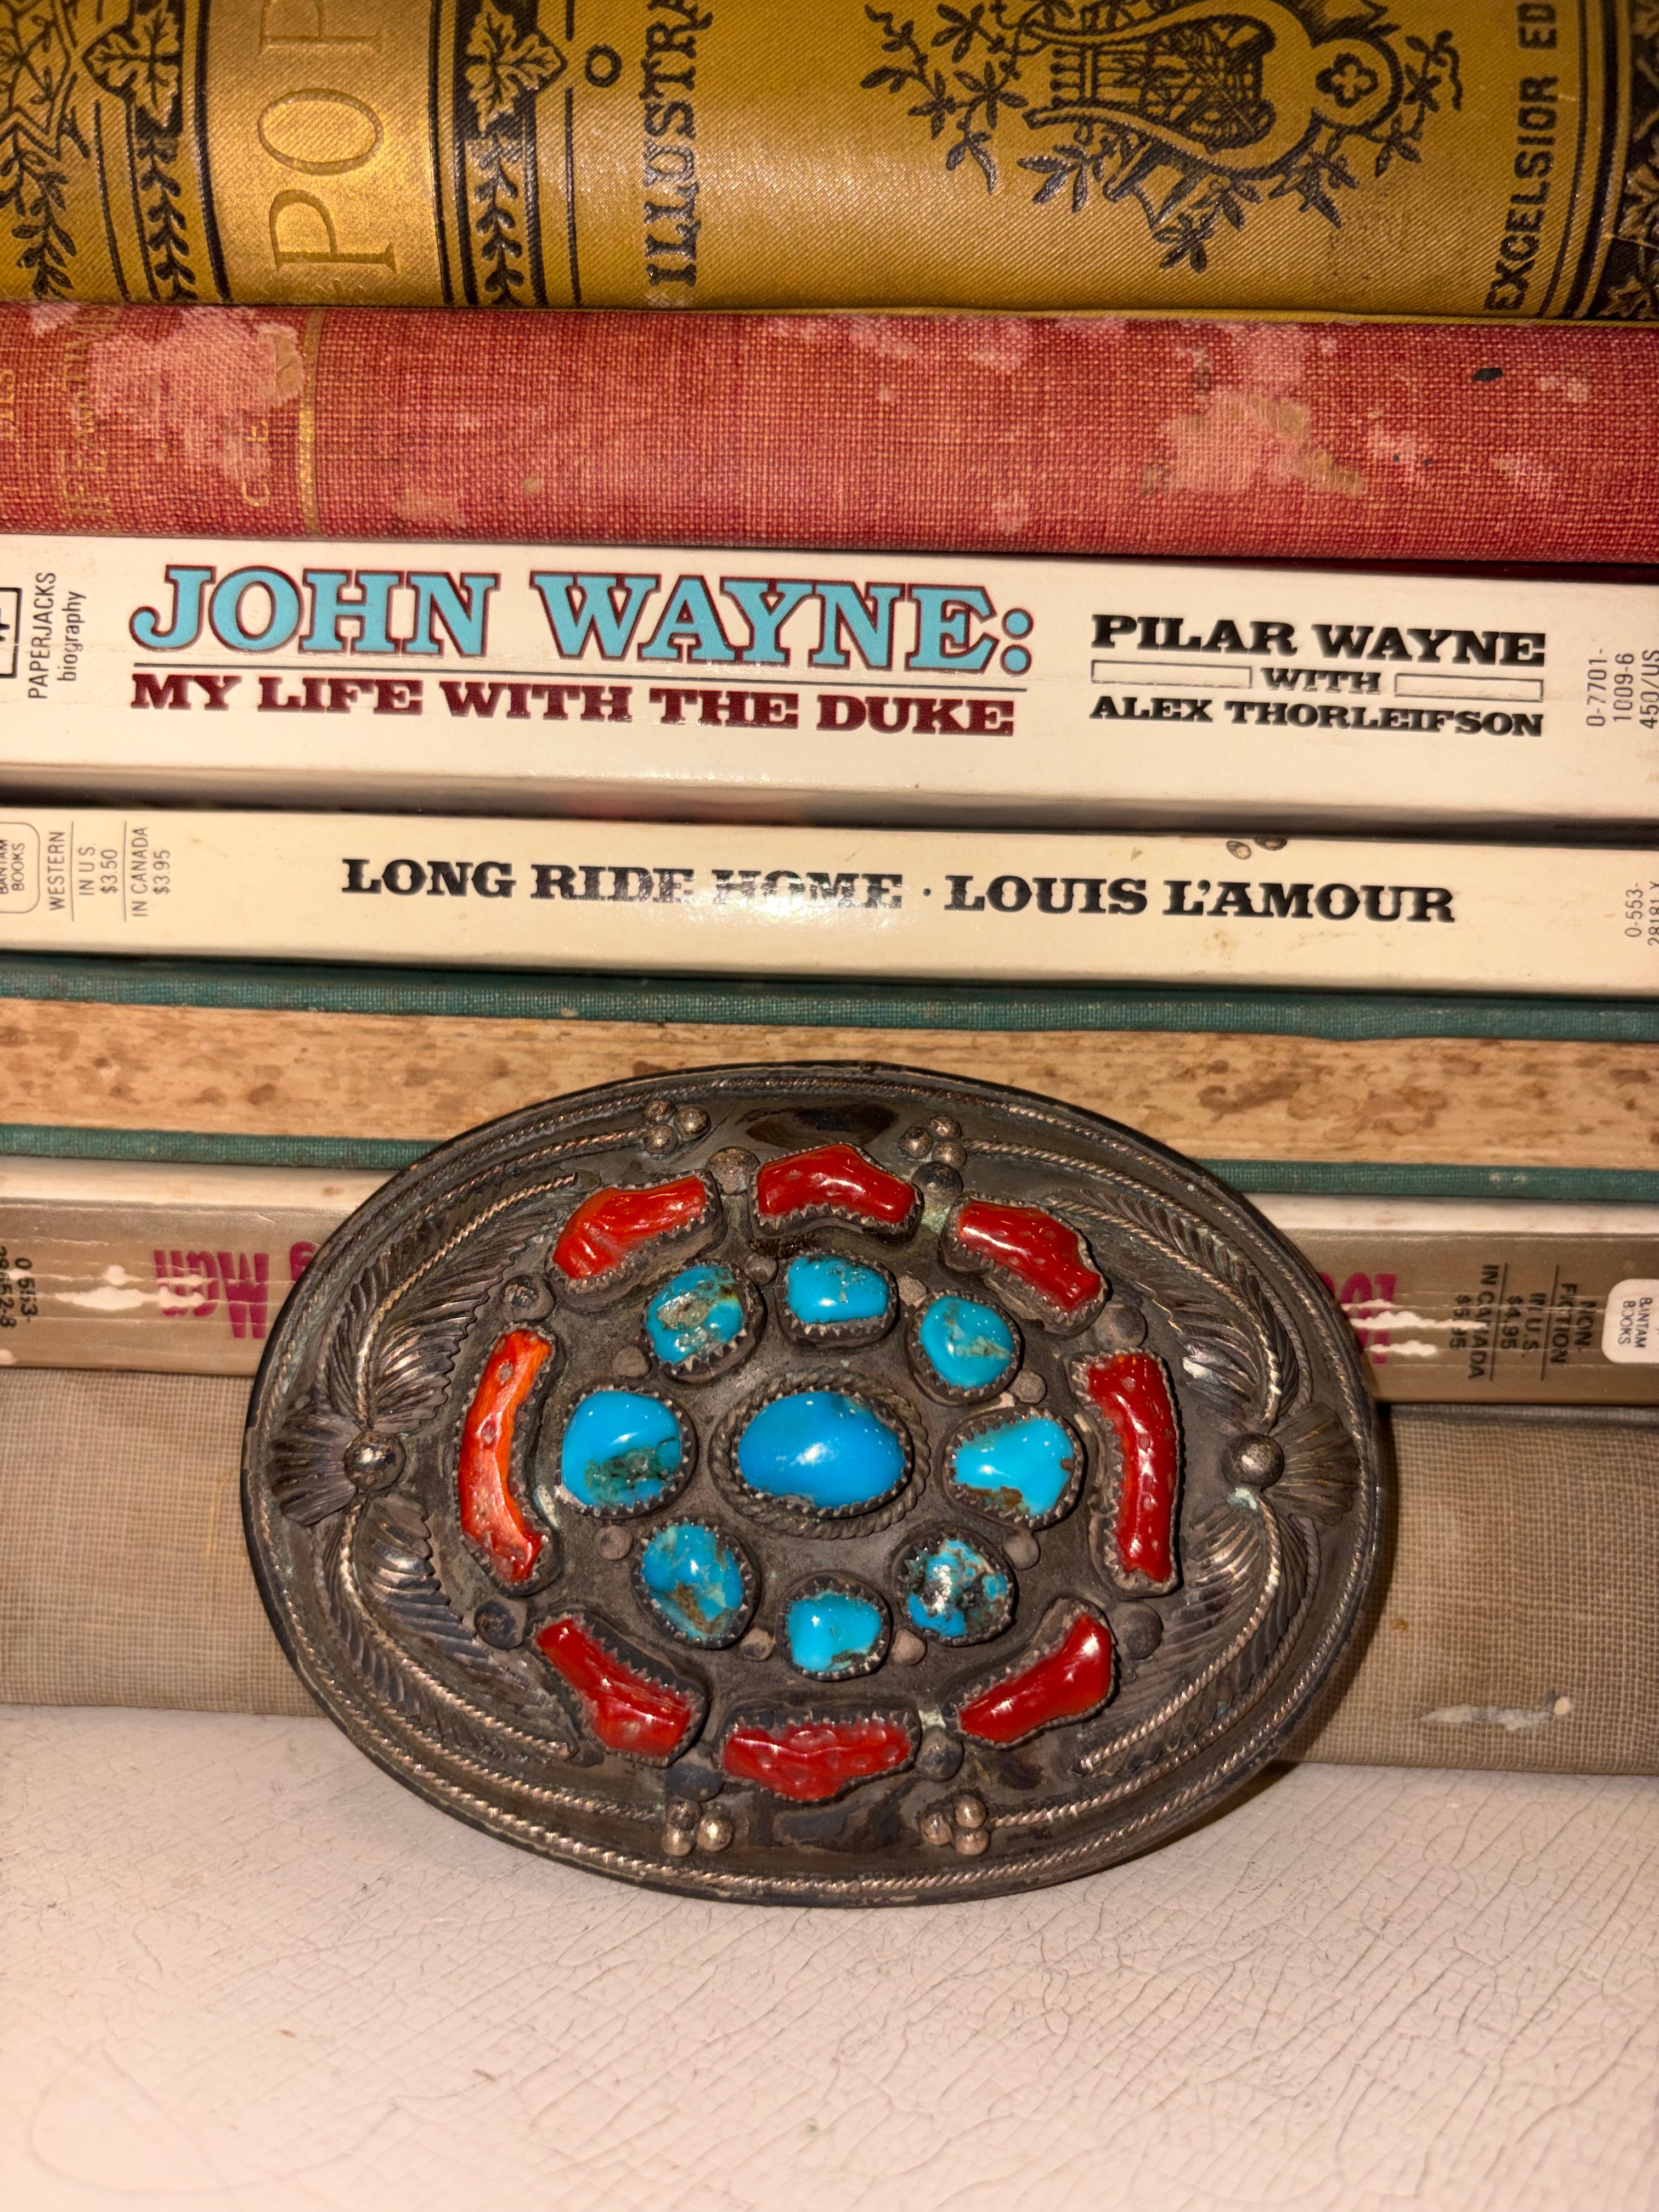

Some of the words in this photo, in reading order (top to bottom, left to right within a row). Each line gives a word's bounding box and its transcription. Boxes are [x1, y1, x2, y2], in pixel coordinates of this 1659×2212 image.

[1516, 3, 1557, 50] ED
[1483, 75, 1559, 311] EXCELSIOR
[29, 572, 57, 698] PAPERJACKS
[57, 591, 87, 681] biography
[129, 565, 501, 658] JOHN
[529, 570, 1034, 676] WAYNE:
[1091, 614, 1297, 657] PILAR
[1312, 624, 1546, 667] WAYNE
[131, 674, 242, 711] MY
[257, 677, 424, 715] LIFE
[439, 681, 632, 722] WITH
[650, 687, 798, 729] THE
[816, 694, 1014, 736] DUKE
[1260, 667, 1381, 695] WITH
[1585, 647, 1607, 727] 0-7701-
[1613, 652, 1634, 722] 1009-6
[1639, 648, 1659, 729] 450/US
[1089, 695, 1213, 723] ALEX
[1224, 700, 1543, 737] THORLEIFSON
[12, 843, 25, 891] BOOKS
[48, 832, 66, 911] WESTERN
[78, 879, 95, 895] IN
[100, 849, 119, 894] $3.50
[131, 827, 149, 894] CANADA
[153, 850, 171, 895] $3.95
[132, 901, 149, 917] IN
[342, 859, 516, 898] LONG
[531, 864, 695, 903] RIDE
[712, 869, 903, 909] HOME
[944, 875, 1148, 915] LOUIS
[1162, 879, 1455, 923] L'AMOUR
[1624, 882, 1644, 939] 0-553-
[1480, 1264, 1499, 1285] IN
[1528, 1292, 1547, 1312] IN
[1449, 1294, 1472, 1349] $55
[1468, 1290, 1495, 1380] CANADA
[1500, 1295, 1523, 1350] $4.95
[1521, 1318, 1543, 1358] U.S.
[1550, 1283, 1577, 1364] FICTION
[1617, 1300, 1635, 1346] BOOKS
